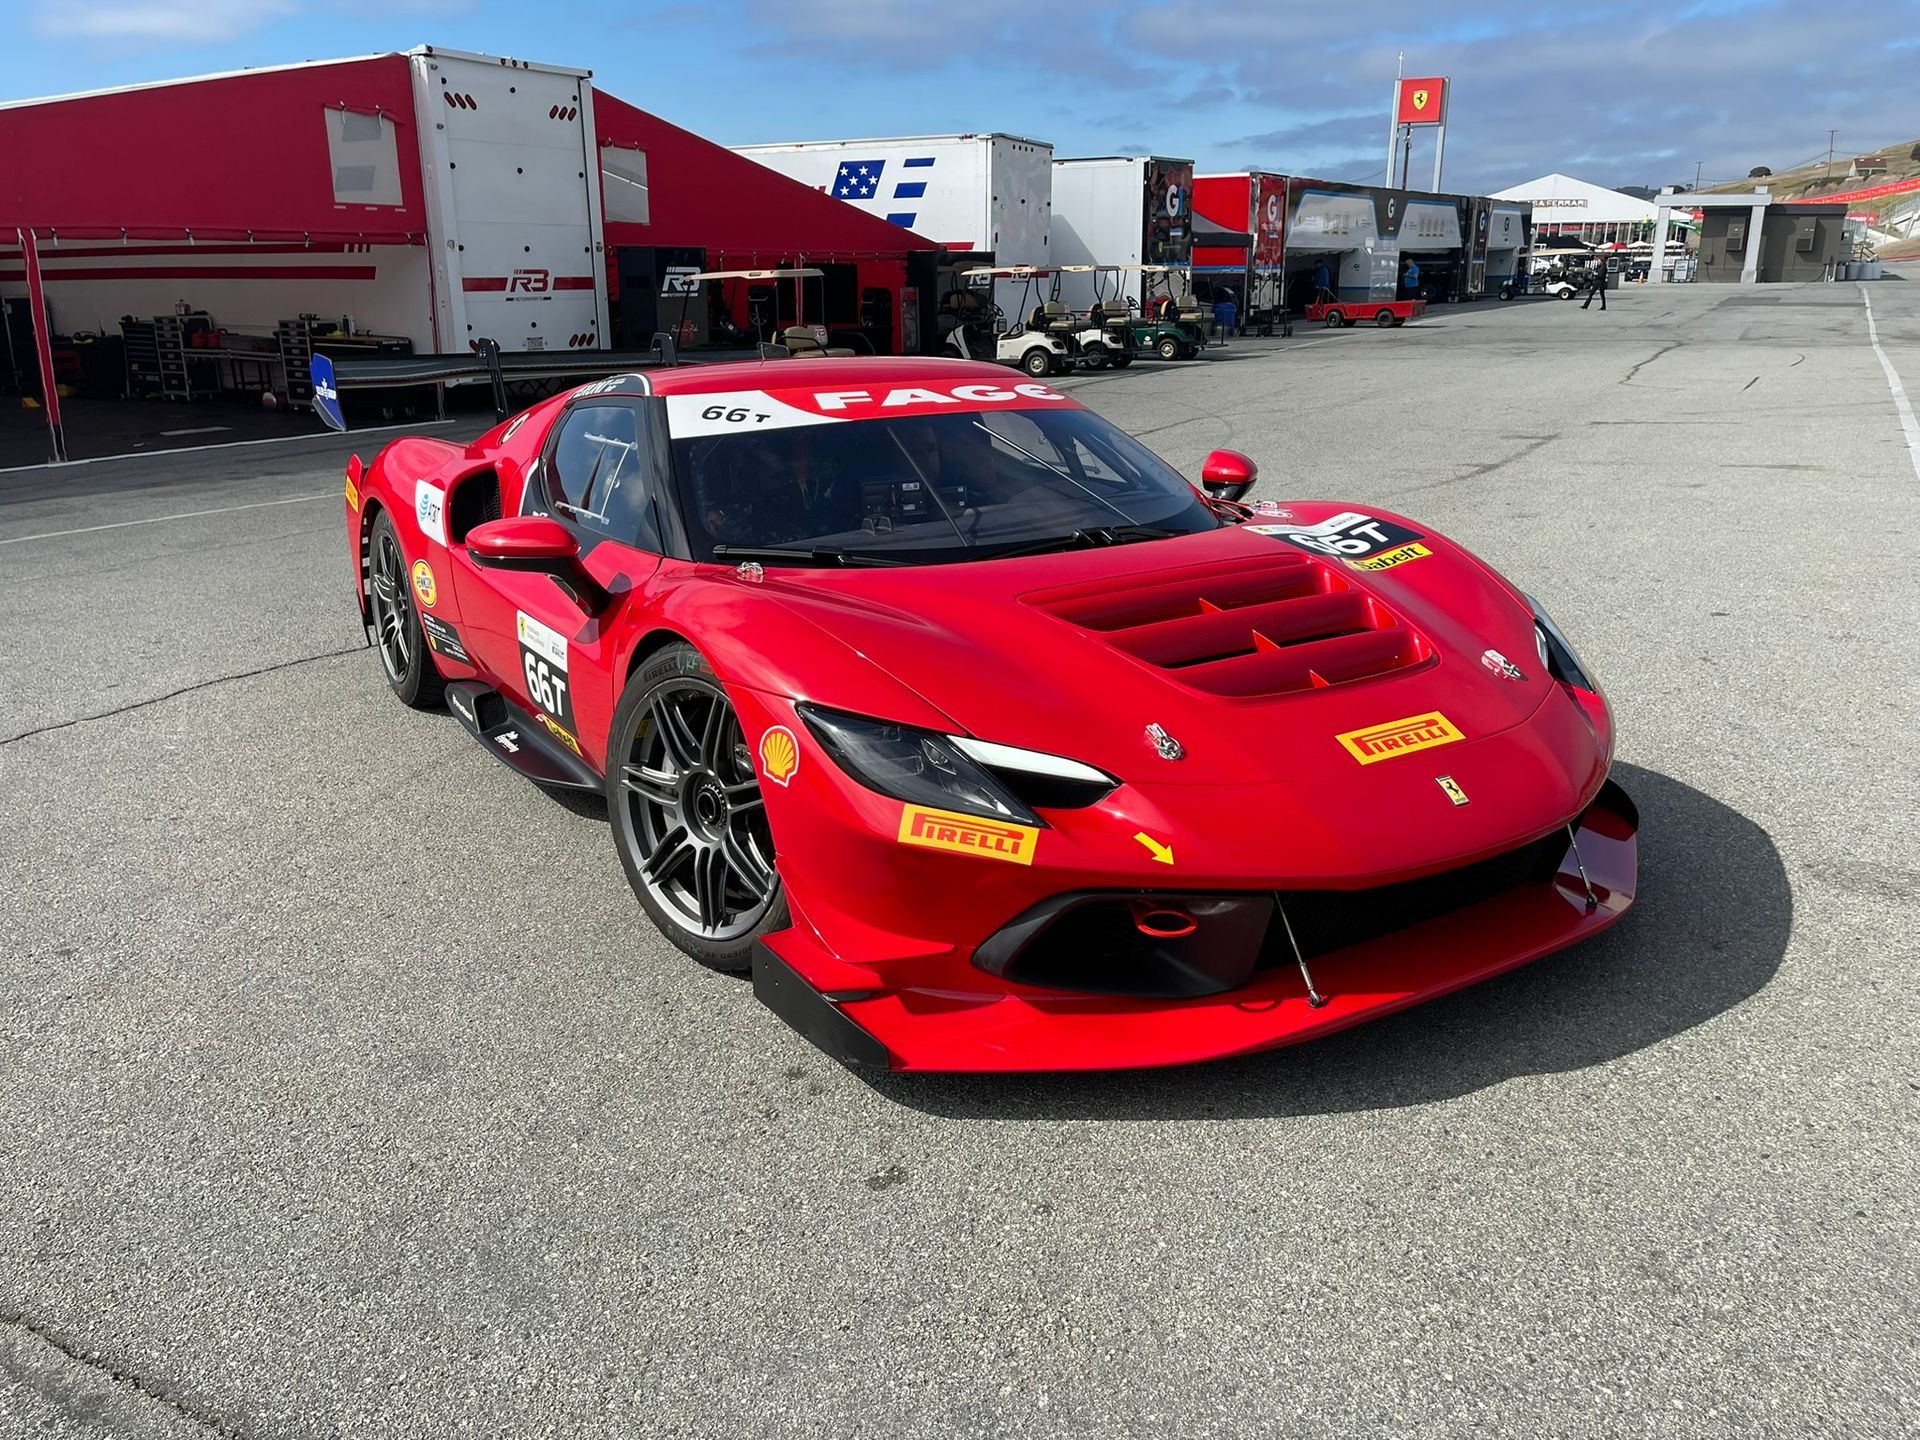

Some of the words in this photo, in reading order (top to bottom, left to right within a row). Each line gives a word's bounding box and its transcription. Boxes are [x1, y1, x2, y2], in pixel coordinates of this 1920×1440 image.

[510, 268, 550, 293] R3
[1289, 521, 1390, 555] 66T
[524, 651, 566, 717] 66T
[1350, 718, 1450, 757] PIRELLI
[910, 812, 1025, 855] PIRELLI
